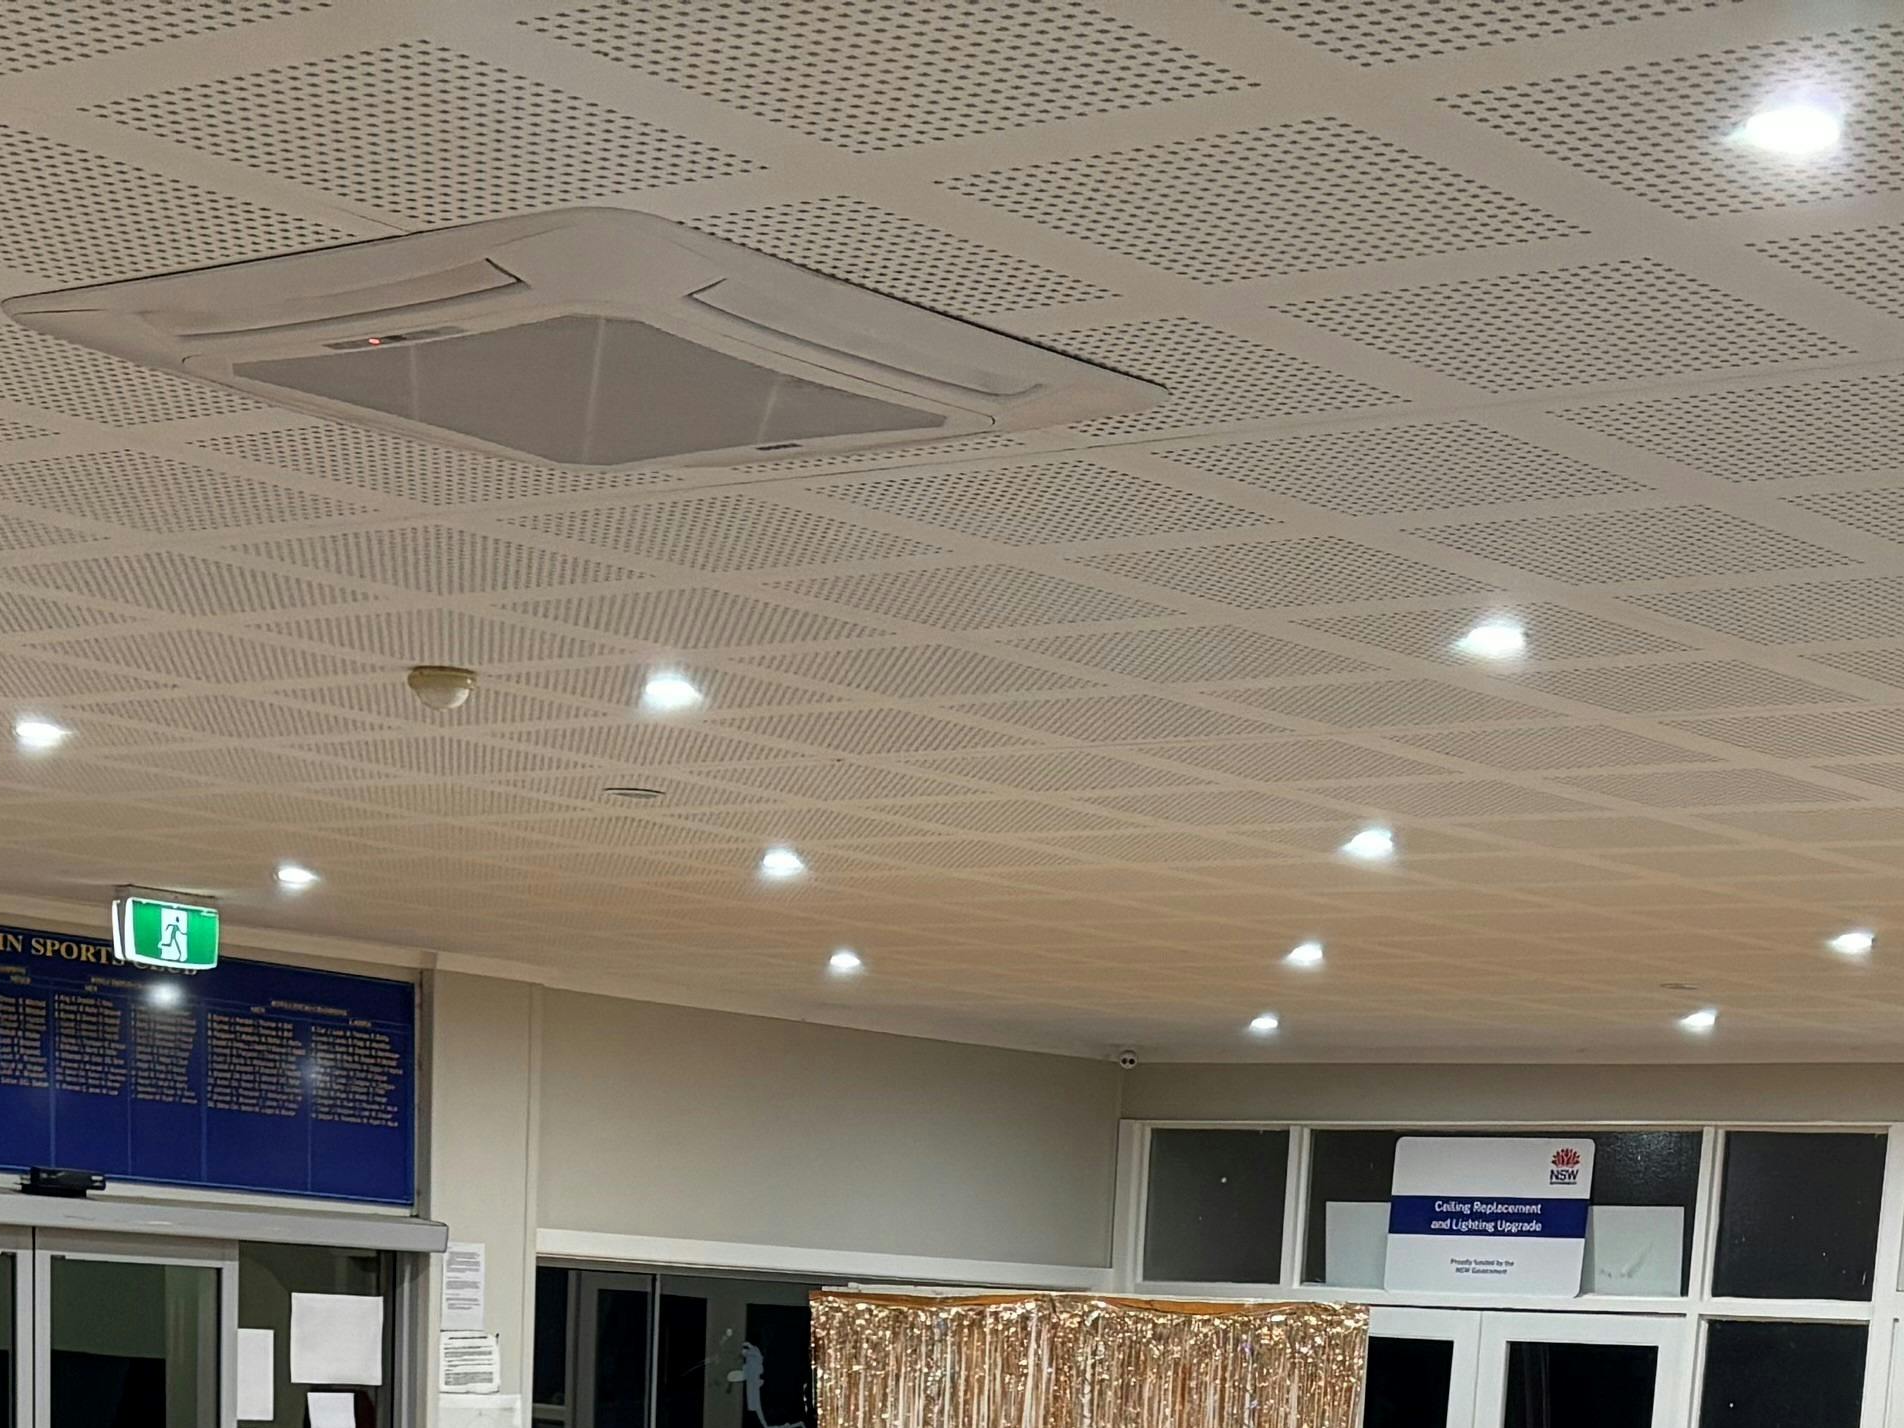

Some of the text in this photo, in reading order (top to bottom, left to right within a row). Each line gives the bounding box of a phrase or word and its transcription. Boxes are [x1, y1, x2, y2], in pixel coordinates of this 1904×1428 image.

[1550, 1169, 1579, 1181] NSW
[1434, 1200, 1542, 1215] Ceiling Replacement
[1430, 1219, 1542, 1234] and Lighting Upgrade
